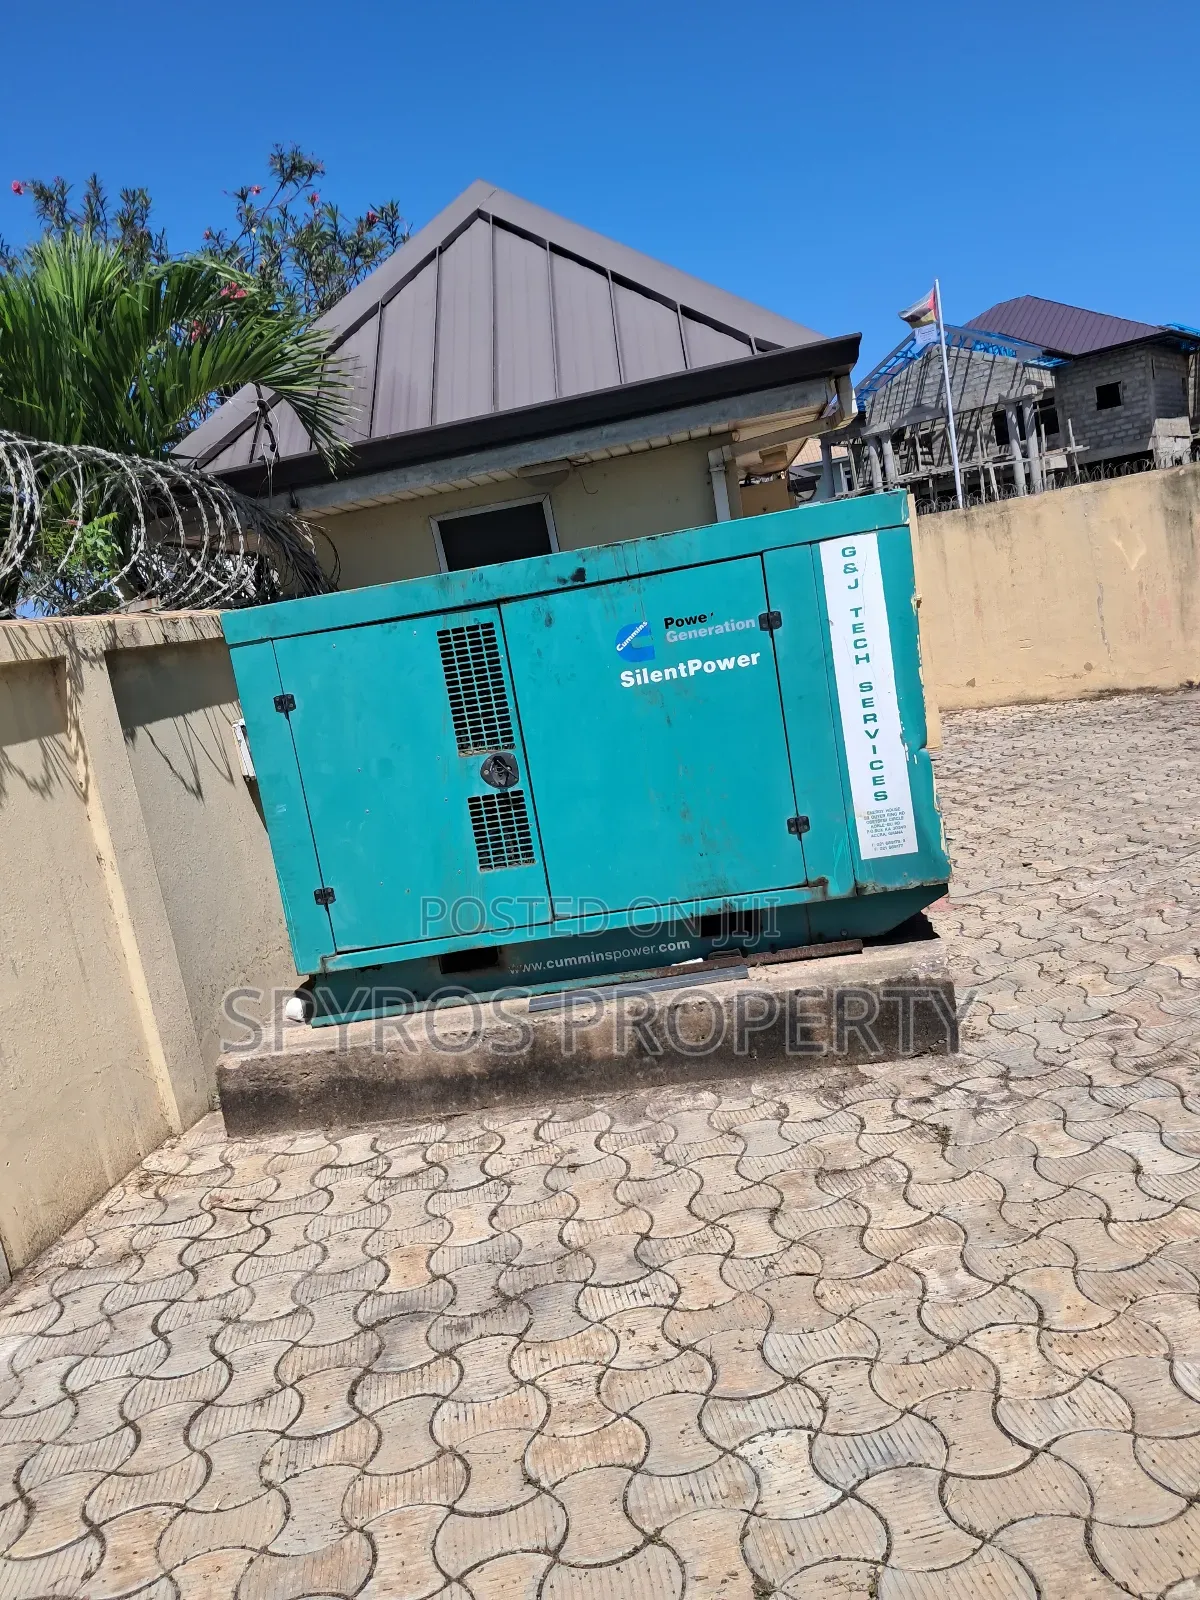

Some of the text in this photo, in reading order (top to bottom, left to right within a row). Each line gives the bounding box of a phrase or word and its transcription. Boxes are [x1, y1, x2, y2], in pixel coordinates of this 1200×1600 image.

[841, 546, 859, 590] G&J
[616, 620, 648, 652] Cummins
[663, 612, 714, 629] Powe
[665, 618, 756, 643] Generation
[849, 606, 871, 665] TECH
[620, 651, 761, 688] SilentPower
[858, 681, 889, 802] SERVICES
